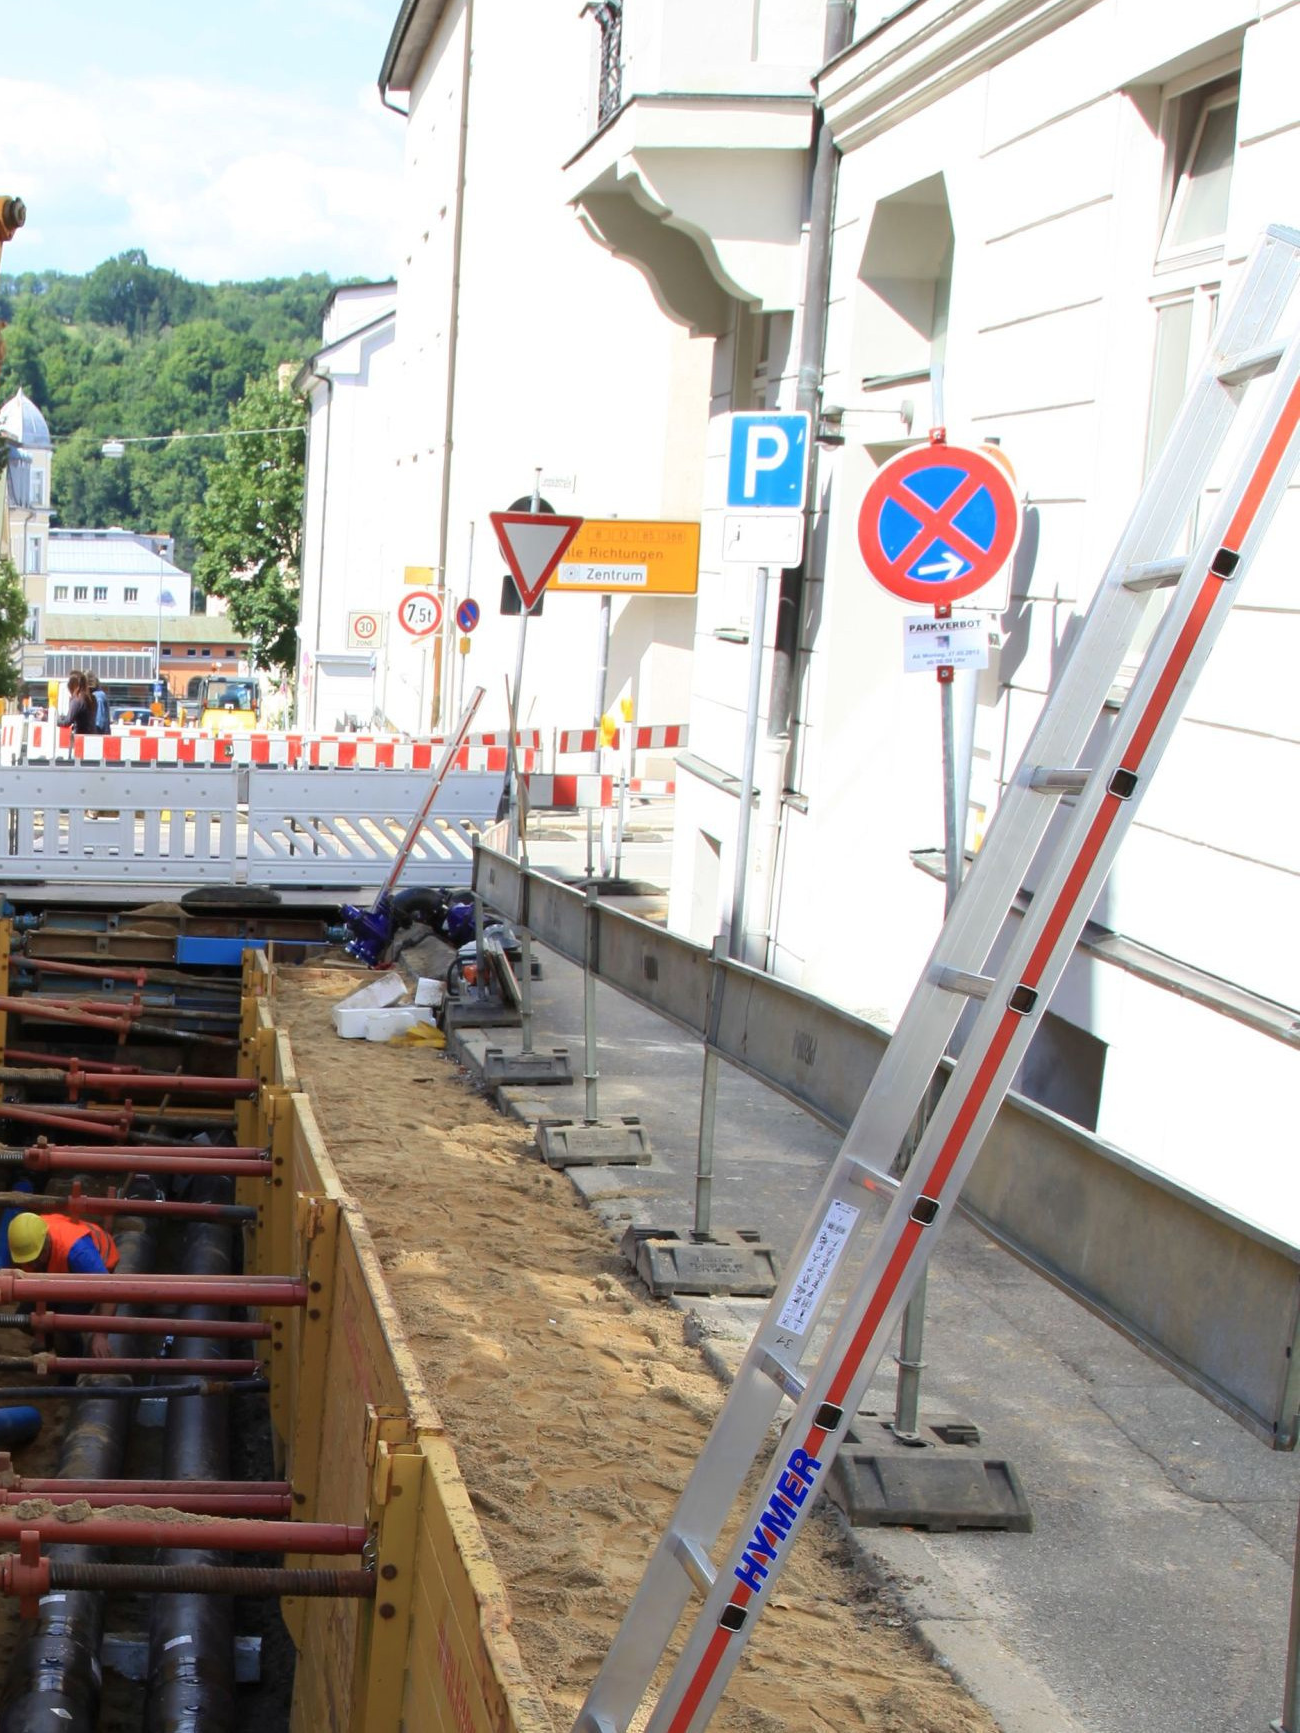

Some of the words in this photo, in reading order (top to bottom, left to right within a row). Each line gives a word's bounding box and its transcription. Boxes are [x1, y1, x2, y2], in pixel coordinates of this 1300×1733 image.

[743, 425, 789, 498] P
[589, 546, 664, 562] Richtungen
[586, 568, 643, 581] Zentrum
[359, 622, 373, 632] 30
[908, 620, 981, 633] PARKVERBOT
[733, 1448, 823, 1594] HYMER
